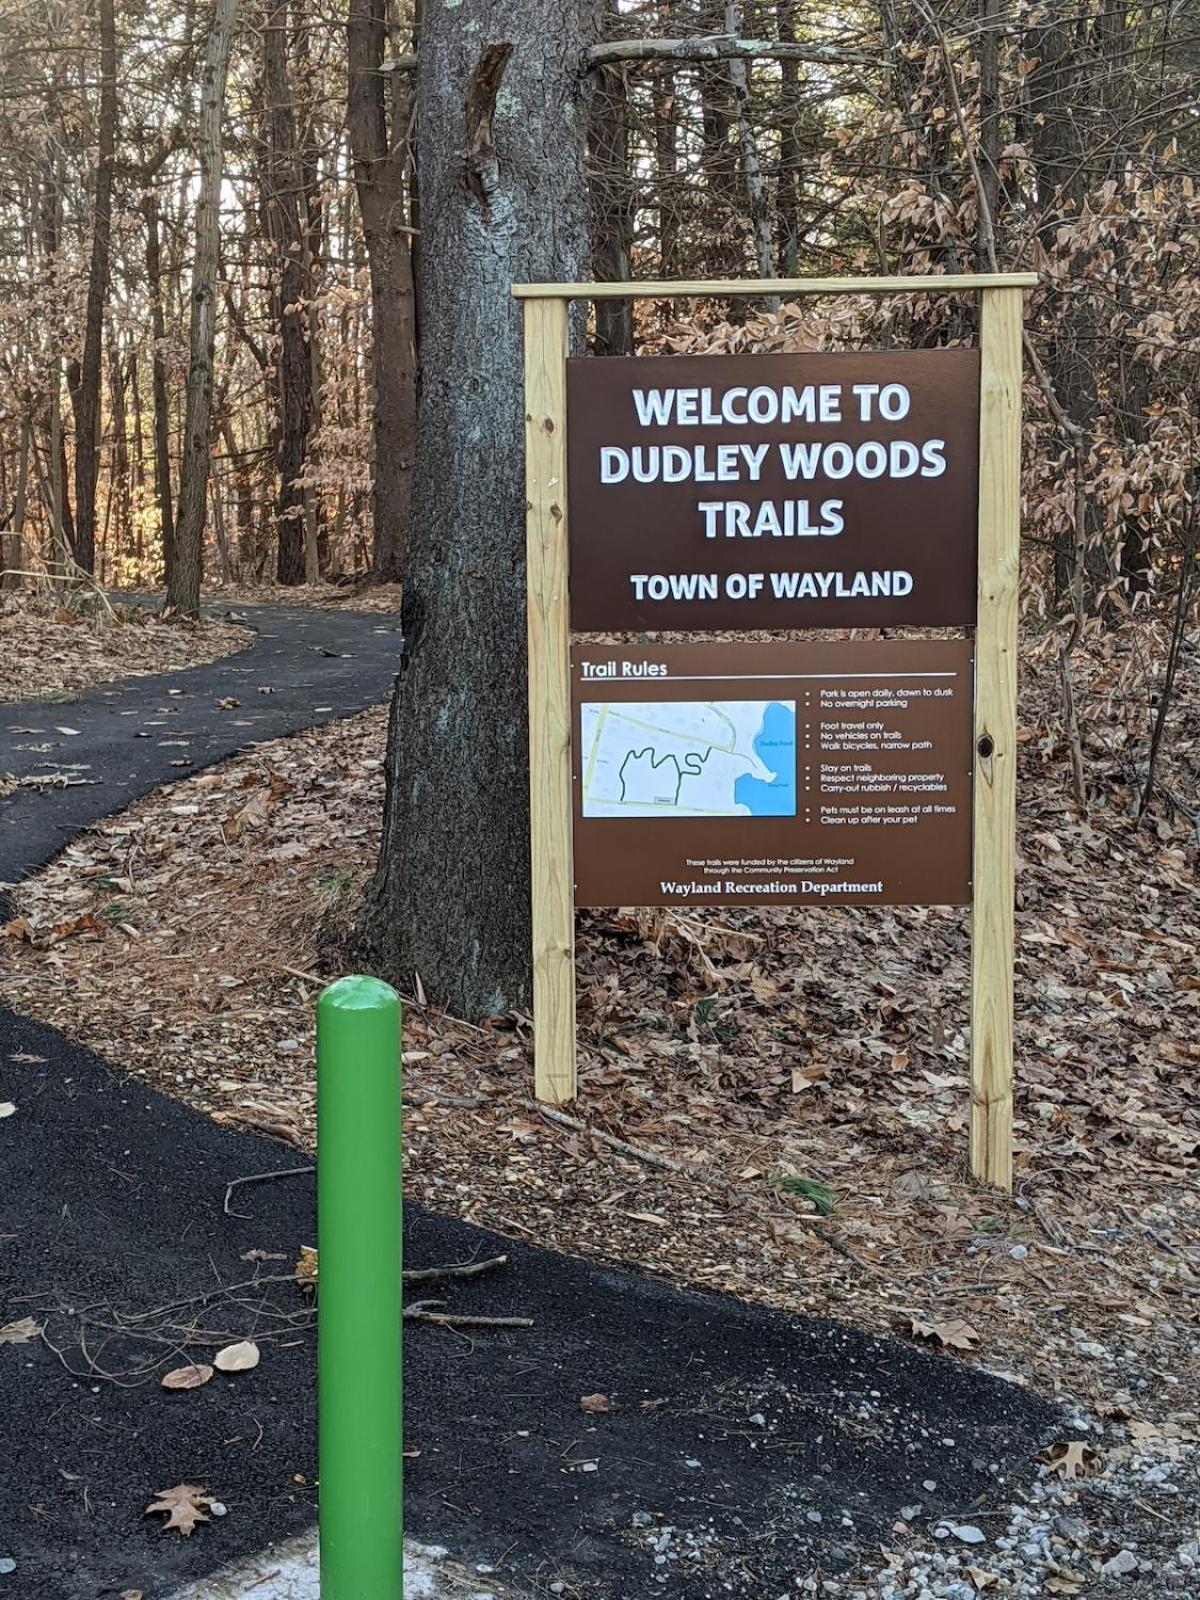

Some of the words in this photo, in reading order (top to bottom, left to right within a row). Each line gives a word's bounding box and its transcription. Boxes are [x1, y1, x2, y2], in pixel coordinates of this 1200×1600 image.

[632, 385, 841, 426] WELCOME
[852, 383, 910, 422] TO
[600, 444, 769, 484] DUDLEY
[779, 439, 946, 480] WOODS
[698, 499, 844, 538] TRAILS
[630, 574, 718, 600] TOWN
[726, 573, 764, 599] OF
[770, 570, 913, 598] WAYLAND
[581, 661, 616, 677] Trail
[622, 660, 667, 676] Rules
[820, 690, 838, 698] Park
[872, 689, 894, 698] daily,
[934, 688, 953, 696] dusk
[820, 700, 833, 708] No
[835, 700, 874, 708] overnight
[876, 699, 908, 708] parking
[820, 722, 839, 730] Foot
[866, 722, 884, 730] only
[820, 732, 832, 740] No
[883, 731, 902, 739] trails
[820, 742, 840, 750] Walk
[842, 742, 879, 750] bicycles,
[912, 741, 932, 750] path
[820, 765, 838, 773] Stay
[853, 764, 872, 772] trails
[820, 774, 855, 783] Respect
[856, 774, 906, 782] neighboring
[908, 774, 944, 782] property
[820, 784, 859, 792] Carry-out
[899, 783, 947, 792] recyclables
[820, 806, 838, 814] Pets
[887, 805, 910, 813] leash
[922, 805, 932, 813] all
[934, 805, 956, 813] times
[820, 816, 846, 824] Clean
[824, 858, 854, 866] Wayland
[704, 867, 730, 875] through
[744, 866, 782, 874] Community
[660, 882, 721, 896] Wayland
[725, 881, 797, 894] Recreation
[801, 881, 883, 896] Department
